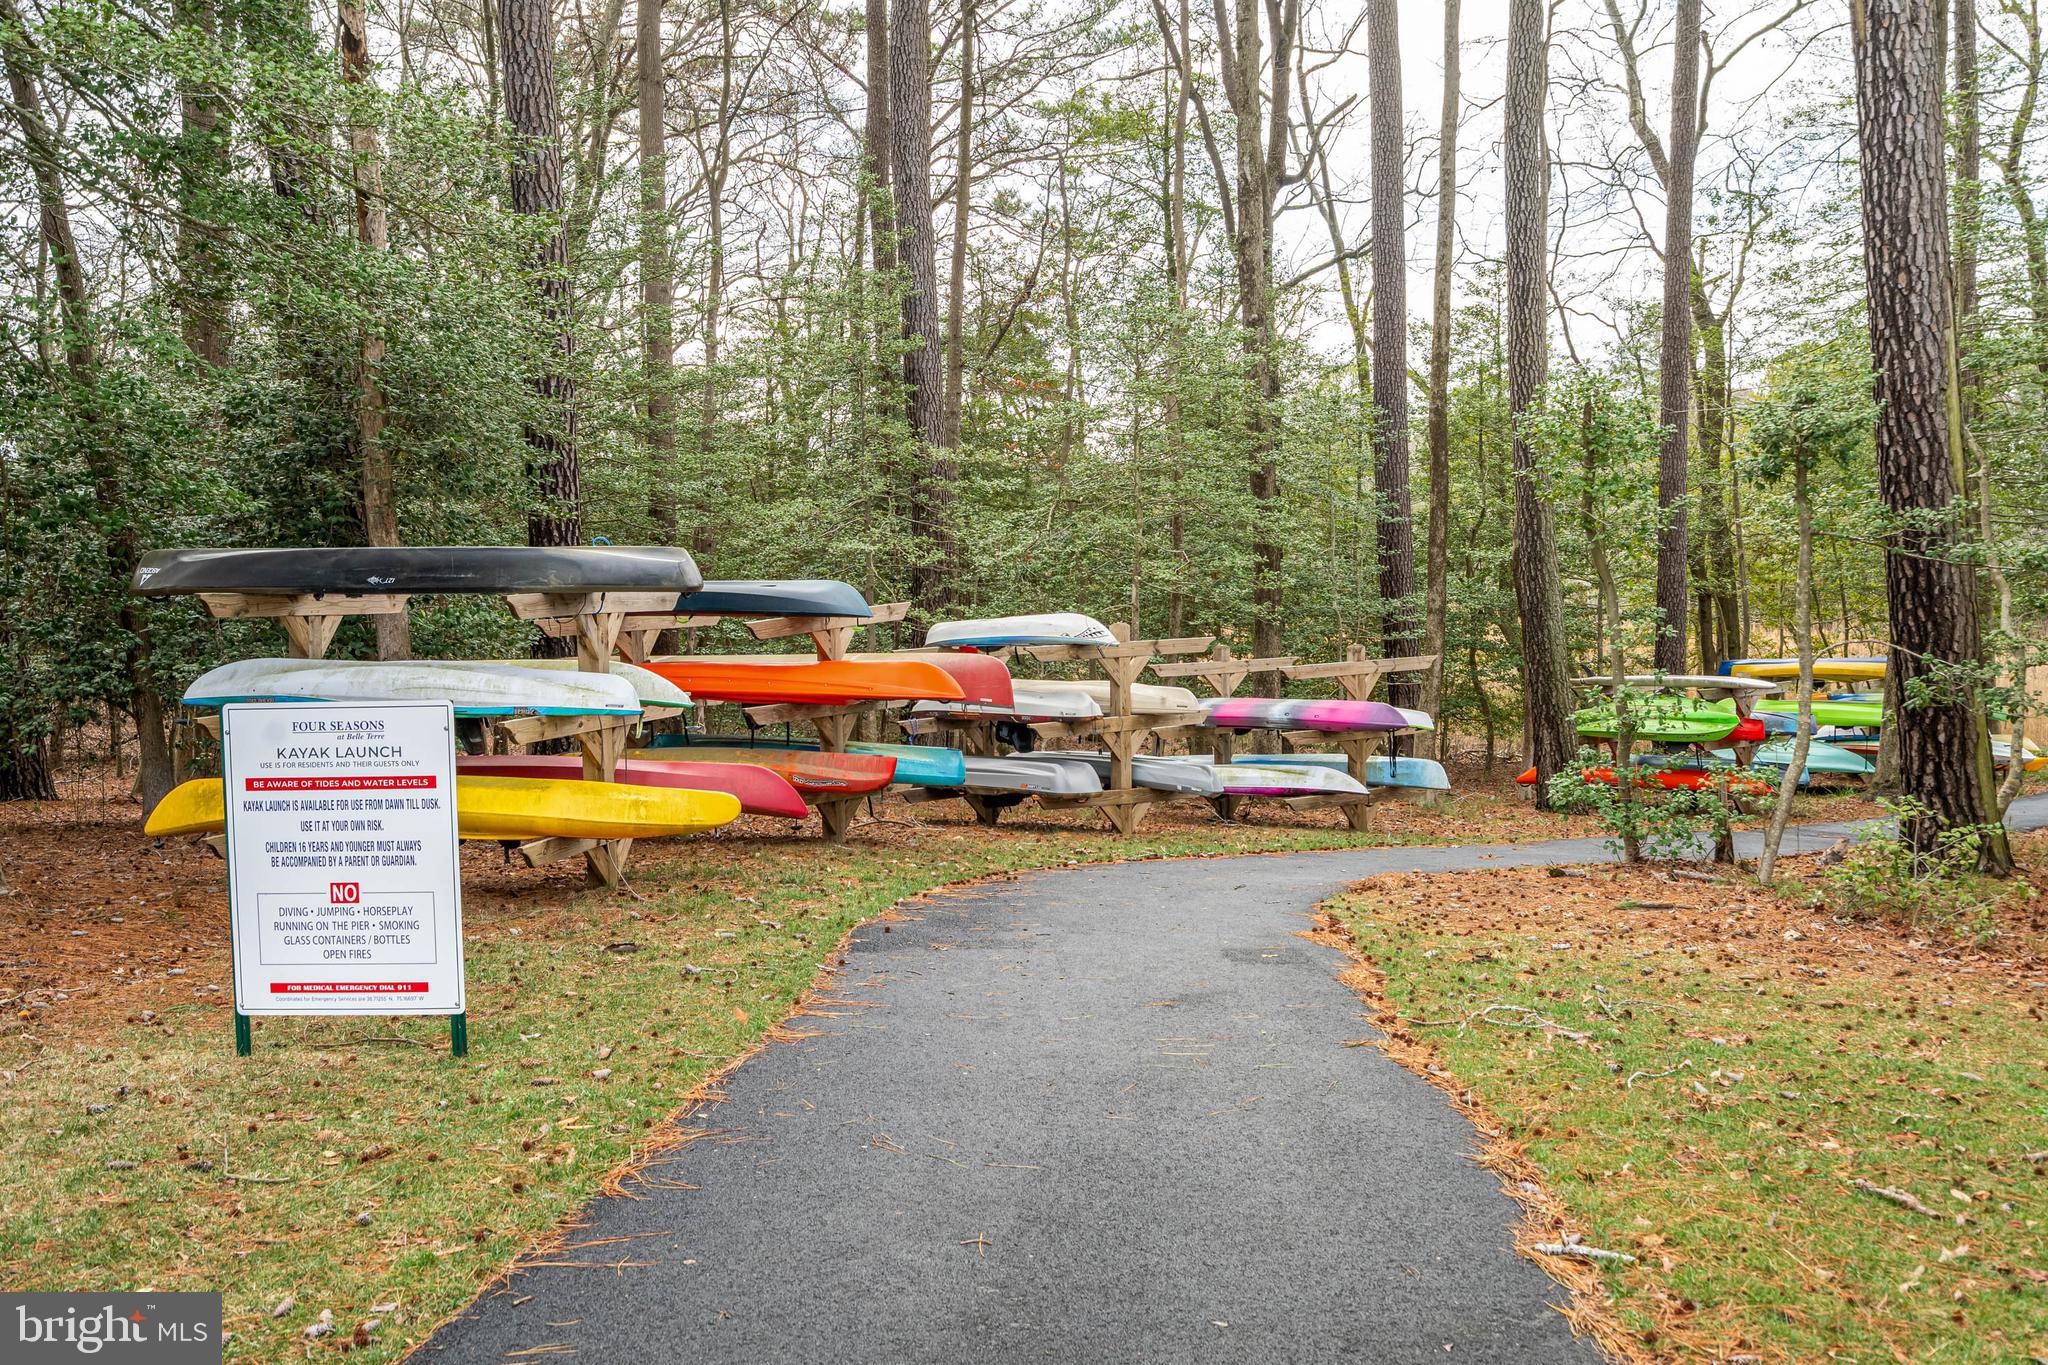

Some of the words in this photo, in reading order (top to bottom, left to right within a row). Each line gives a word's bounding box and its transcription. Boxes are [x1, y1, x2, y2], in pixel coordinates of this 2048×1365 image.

[292, 721, 327, 732] FOUR
[330, 720, 385, 731] SEASONS
[277, 746, 330, 759] KAYAK
[336, 745, 402, 758] LAUNCH
[260, 761, 273, 769] USE
[401, 759, 420, 767] ONLY
[253, 780, 265, 788] BE
[266, 780, 299, 788] AWARE
[300, 780, 313, 788] OF
[341, 779, 361, 787] AND
[363, 779, 395, 787] WATER
[396, 778, 429, 786] LEVELS
[243, 799, 264, 811] KAYAK
[265, 799, 291, 811] LAUNCH
[292, 799, 299, 811] IS
[300, 799, 335, 811] AVAILABLE
[336, 799, 350, 810] FOR
[350, 799, 363, 810] USE
[365, 798, 384, 810] FROM
[385, 798, 405, 810] DAWN
[406, 798, 420, 809] TILL
[421, 797, 441, 809] DUSK.
[300, 820, 313, 831] USE
[314, 820, 320, 831] IT
[321, 820, 330, 831] AT
[331, 819, 349, 831] YOUR
[350, 819, 366, 831] OWN
[367, 819, 385, 831] RISK.
[265, 841, 297, 853] CHILDREN
[298, 841, 307, 852] 16
[307, 841, 329, 852] YEARS
[330, 840, 344, 852] AND
[345, 840, 375, 852] YOUNGER
[376, 840, 395, 852] MUST
[396, 839, 422, 851] ALWAYS
[271, 856, 280, 867] BE
[281, 856, 327, 867] ACCOMPANIED
[328, 856, 337, 867] BY
[338, 855, 344, 866] A
[344, 855, 369, 866] PARENT
[370, 855, 380, 866] OR
[381, 854, 417, 866] GUARDIAN.
[331, 884, 358, 902] NO
[278, 907, 309, 917] DIVING
[316, 906, 355, 917] JUMPING
[363, 905, 413, 916] HORSEPLAY
[273, 921, 314, 931] RUNNING
[315, 921, 329, 931] ON
[332, 921, 349, 930] THE
[351, 920, 370, 930] PIER
[379, 920, 420, 930] SMOKING
[283, 935, 311, 945] GLASS
[312, 935, 367, 945] CONTAINERS
[373, 935, 411, 945] BOTTLES
[323, 949, 347, 959] OPEN
[349, 949, 372, 959] FIRES
